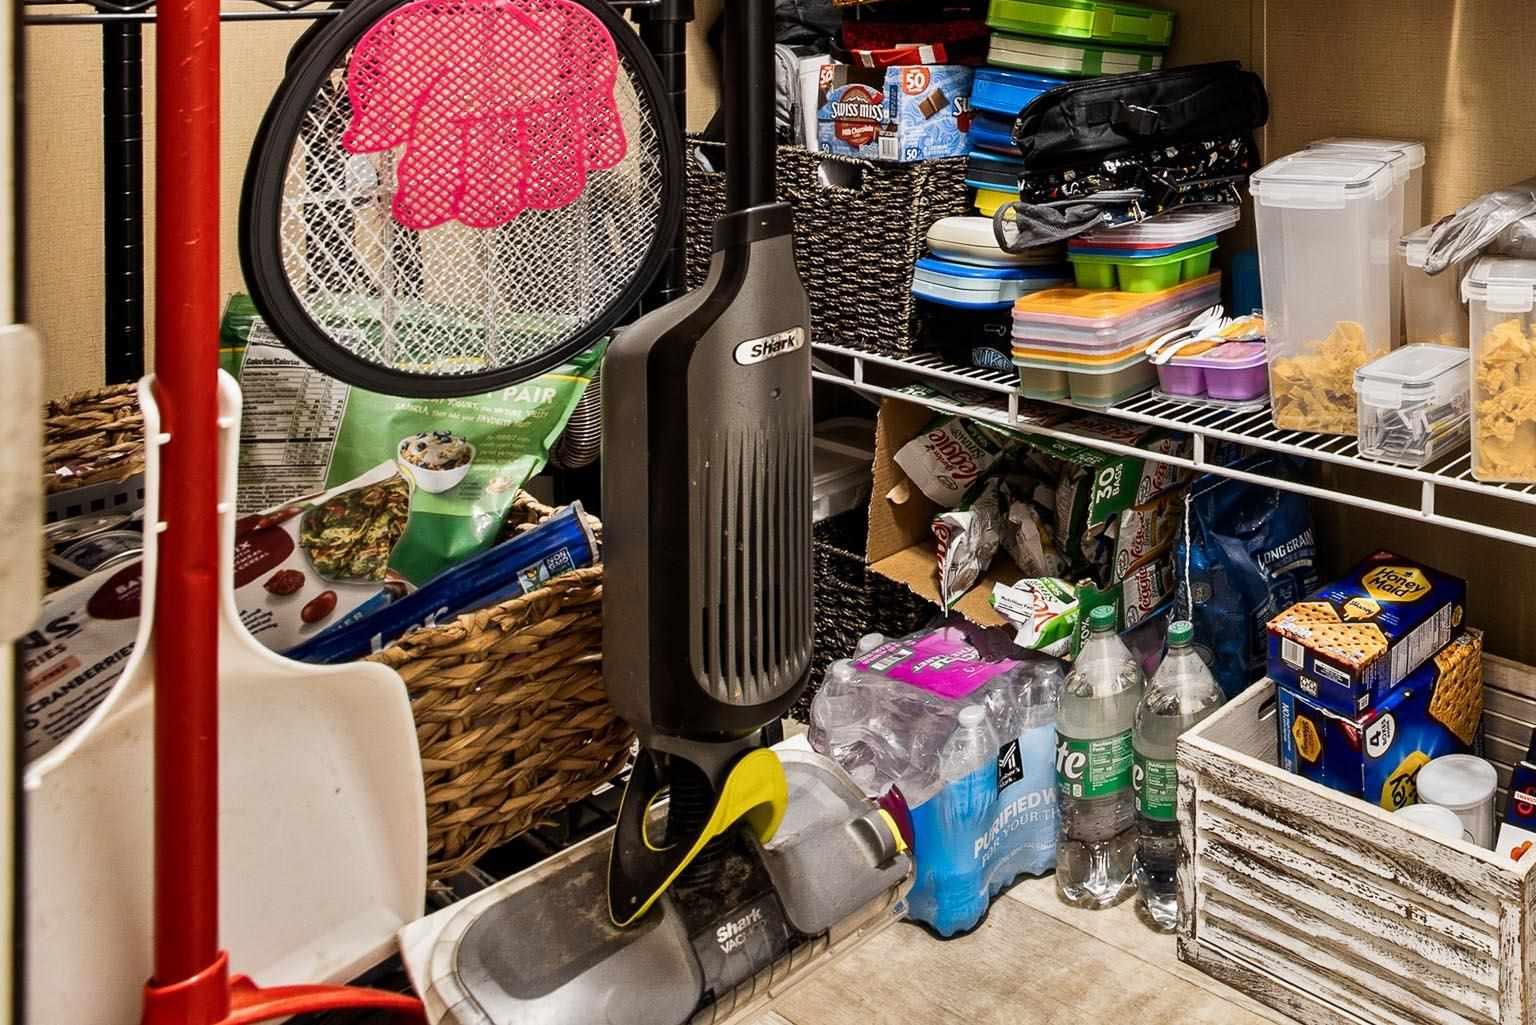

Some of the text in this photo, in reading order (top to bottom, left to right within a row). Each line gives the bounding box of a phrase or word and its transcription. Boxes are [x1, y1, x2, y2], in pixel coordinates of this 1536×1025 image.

[905, 73, 926, 90] 50
[906, 147, 919, 160] 50
[750, 334, 796, 357] Shark
[503, 386, 558, 404] PAIR
[1096, 463, 1114, 506] 30
[1111, 463, 1124, 497] BAGS
[1257, 544, 1287, 571] LONG
[1369, 577, 1410, 598] Maid
[1376, 567, 1426, 594] Honey
[973, 790, 1040, 860] PURIFIED
[716, 907, 762, 944] Shark
